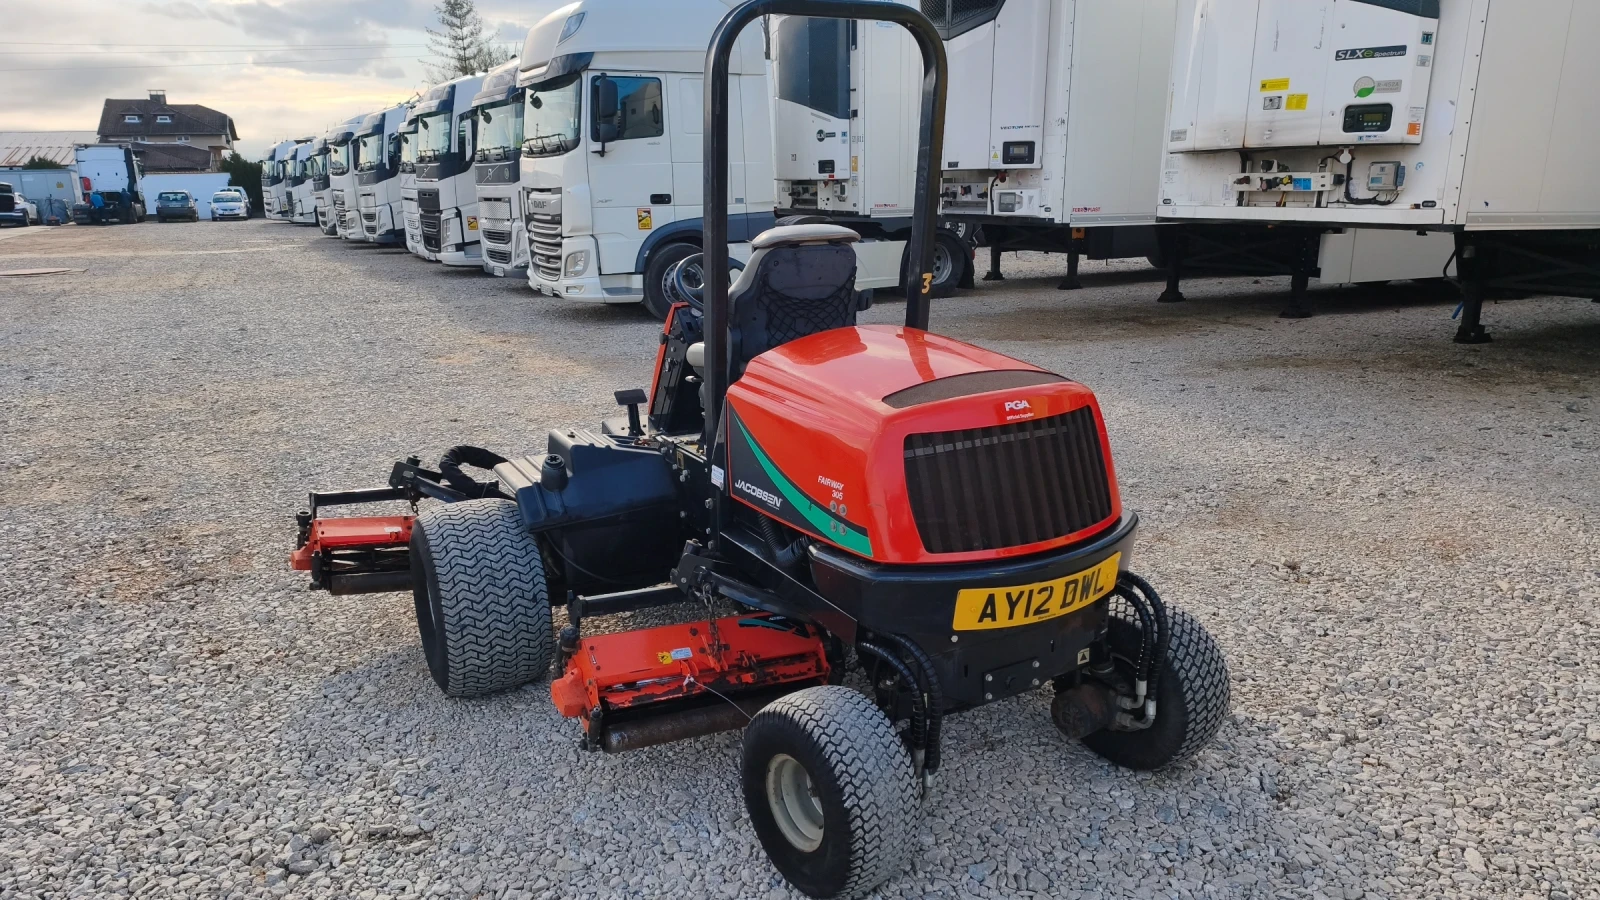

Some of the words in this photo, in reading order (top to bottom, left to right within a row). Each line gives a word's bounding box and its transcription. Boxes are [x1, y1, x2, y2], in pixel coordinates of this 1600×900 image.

[533, 201, 547, 209] DAF
[921, 272, 933, 294] 3
[1004, 399, 1031, 412] PGA
[817, 475, 844, 490] FAIRWAY
[734, 479, 783, 508] JACOBSEN
[831, 489, 843, 501] 305
[977, 585, 1055, 624] AY12
[1059, 567, 1104, 610] DWL
